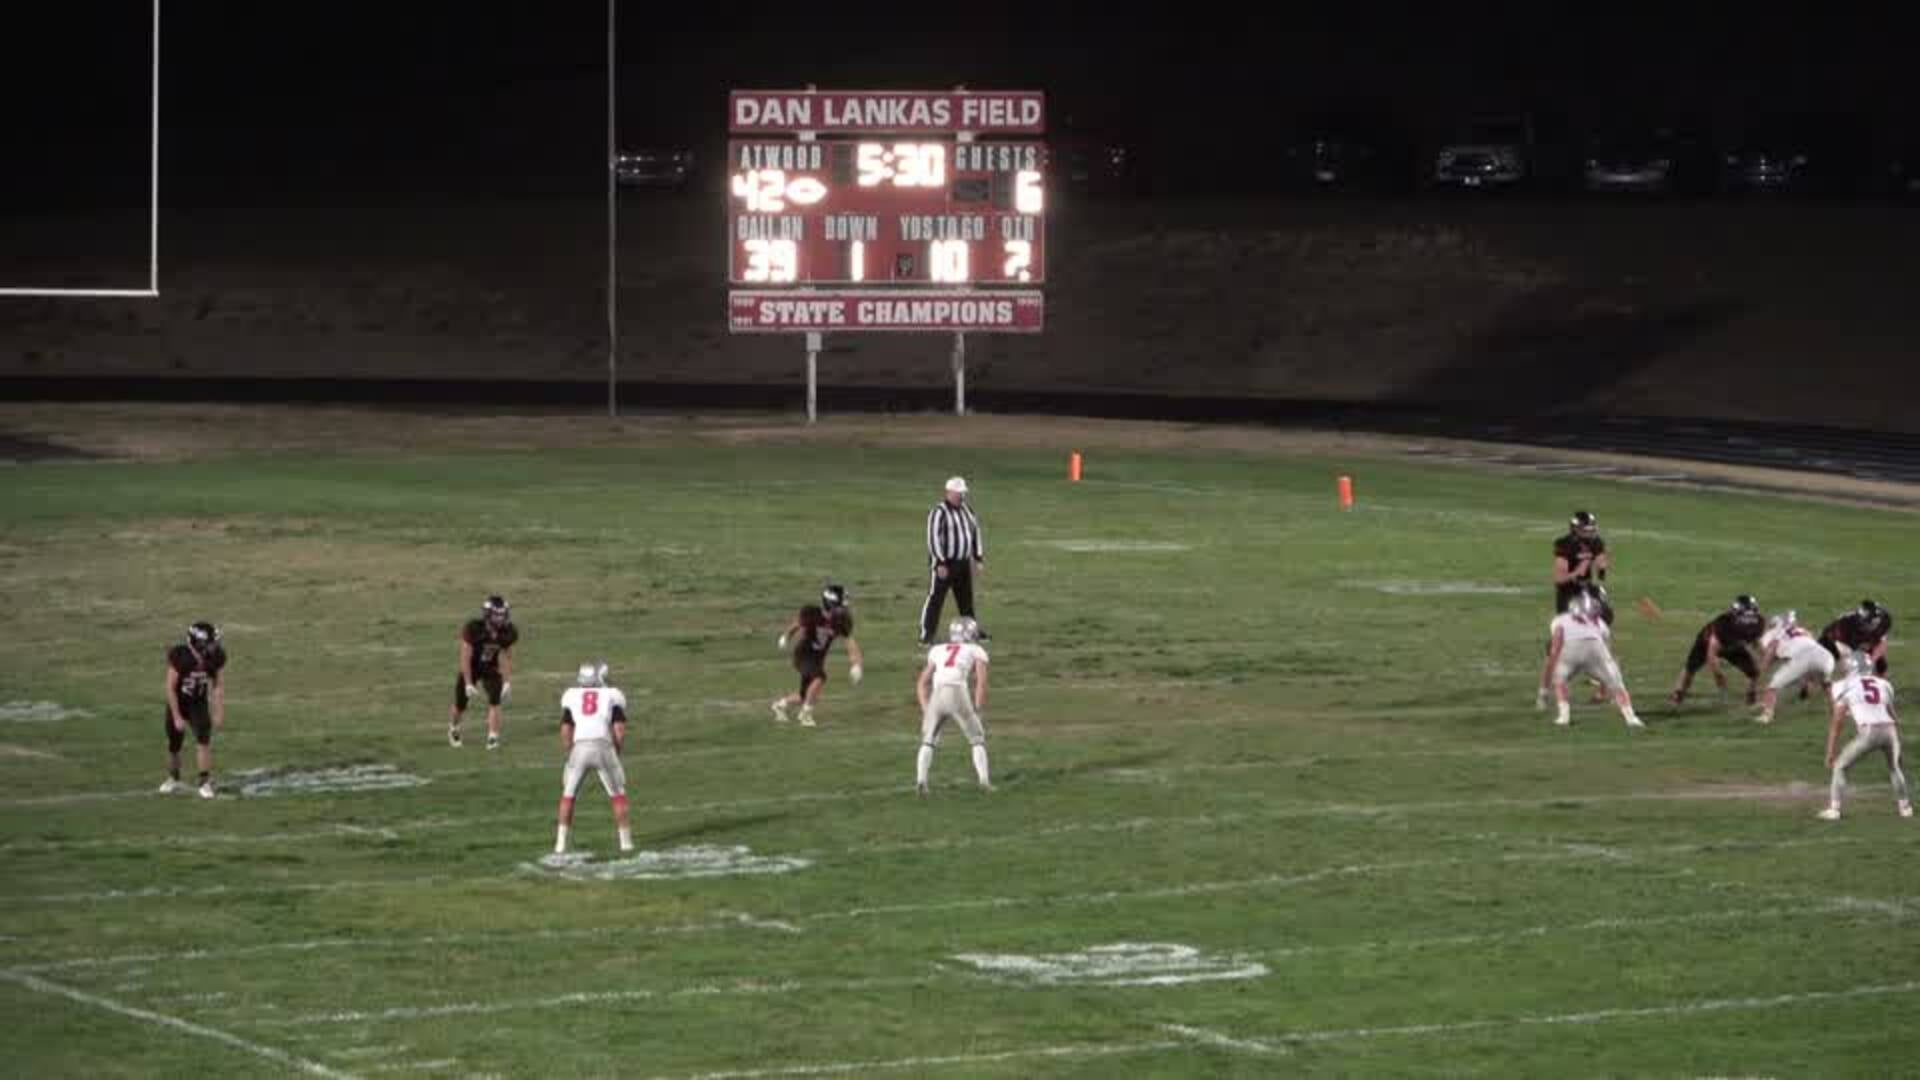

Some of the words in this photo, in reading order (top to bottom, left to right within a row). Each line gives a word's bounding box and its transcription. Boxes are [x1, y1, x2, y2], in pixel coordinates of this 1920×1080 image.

[736, 98, 811, 125] DAN
[824, 98, 951, 125] LANKAS
[962, 98, 1041, 125] FIELD
[741, 144, 822, 170] ATWOOD
[857, 143, 945, 187] 5:30
[956, 145, 1037, 171] GUESTS
[732, 170, 785, 212] 42
[1015, 170, 1043, 214] 6
[825, 215, 878, 240] DOWN
[1001, 215, 1034, 240] QTR
[851, 240, 864, 282] 1
[930, 239, 969, 282] 10
[758, 301, 845, 324] STATE
[857, 301, 1013, 324] CHAMPIONS
[944, 644, 961, 668] 7
[582, 691, 599, 716] 8
[1861, 679, 1880, 705] 5
